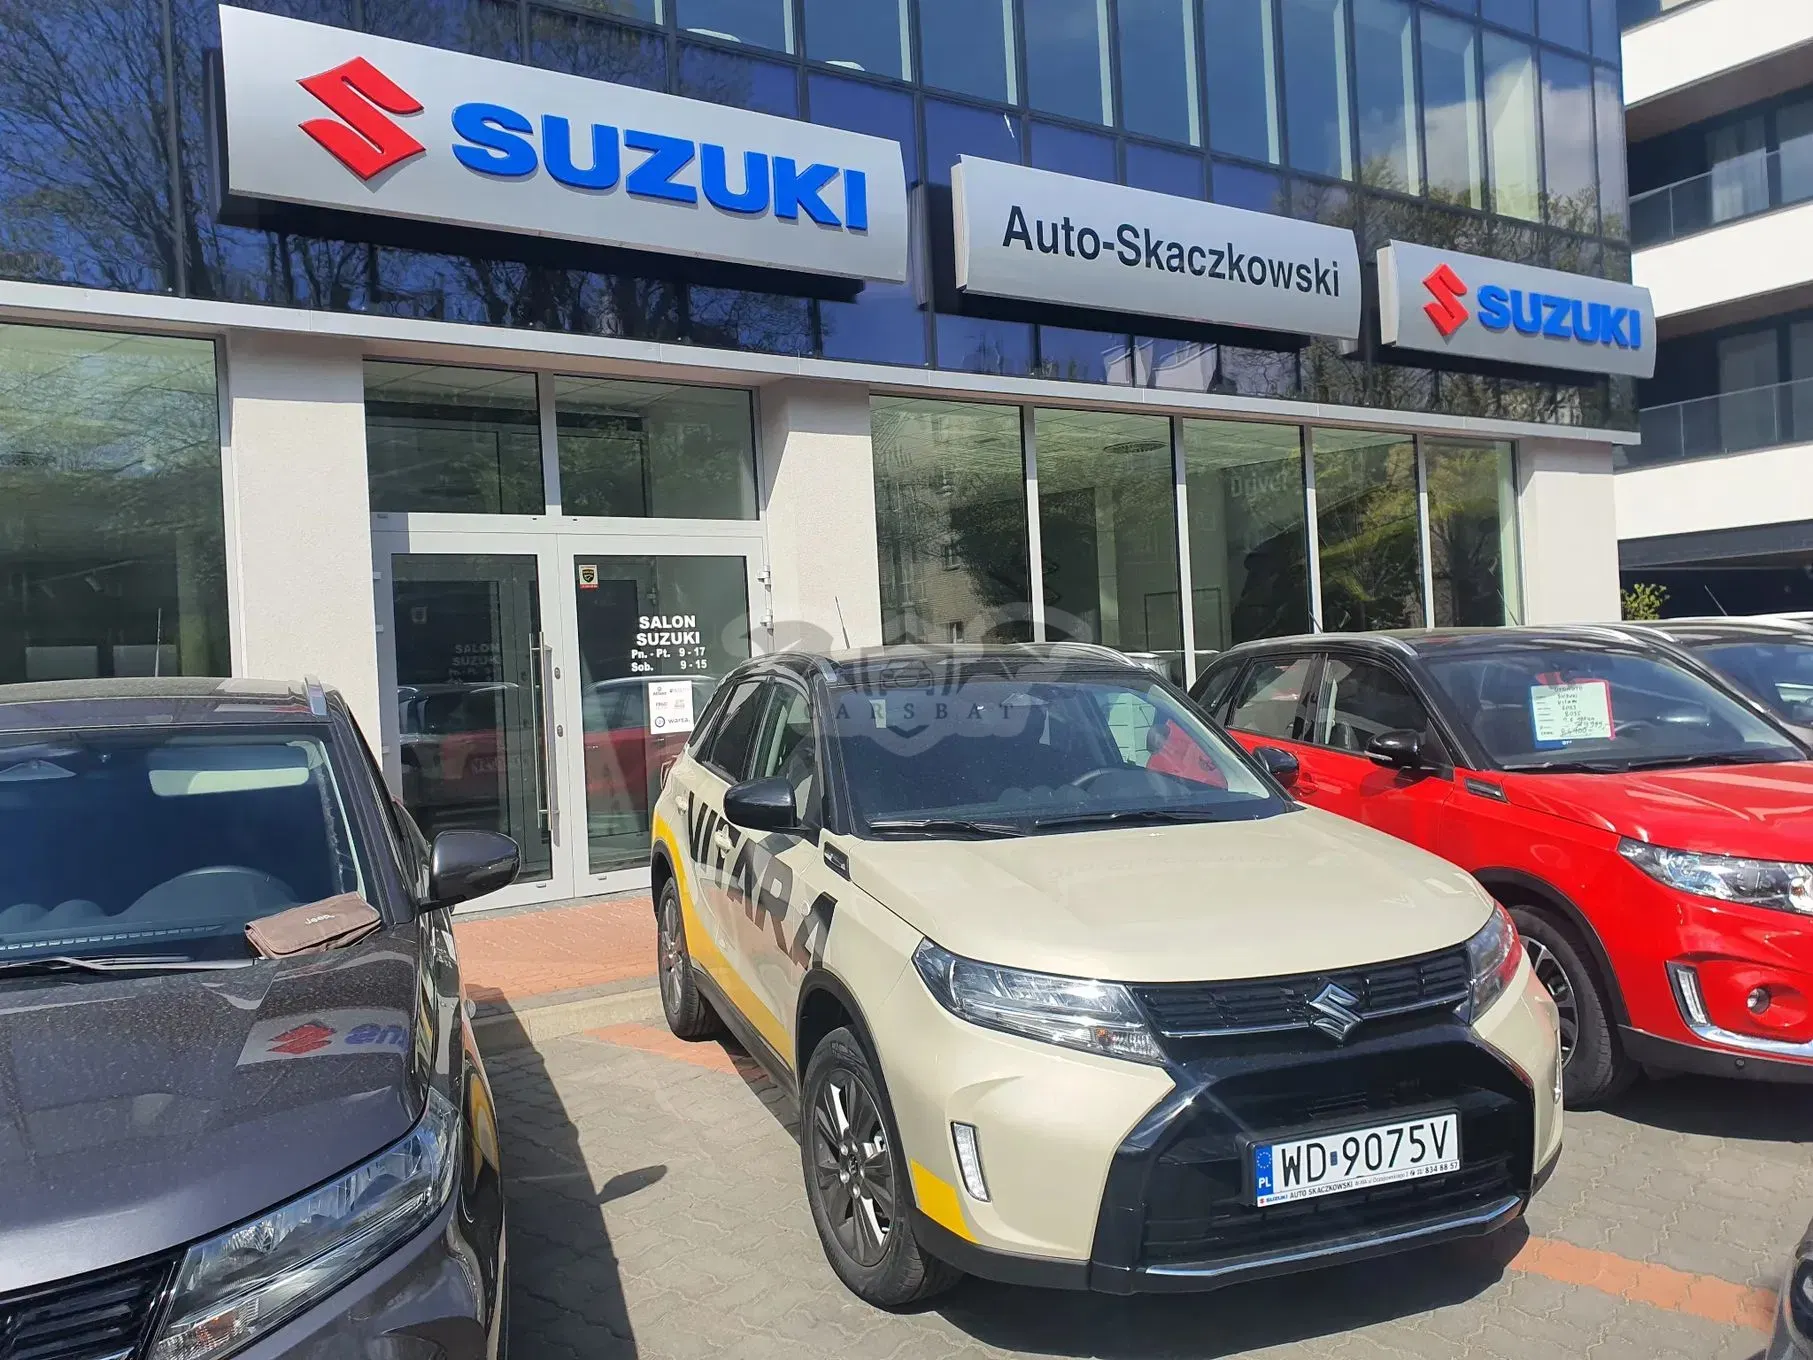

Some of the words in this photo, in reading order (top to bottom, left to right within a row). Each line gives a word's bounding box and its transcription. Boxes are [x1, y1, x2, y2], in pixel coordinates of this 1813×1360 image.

[450, 102, 868, 233] SUZUKI
[1001, 204, 1340, 299] Auto-Skaczkowski
[1477, 284, 1641, 350] SUZUKI
[636, 631, 700, 646] SUZUKI
[639, 615, 696, 629] SALON
[631, 649, 648, 659] Pn.
[656, 648, 671, 658] Pt.
[678, 647, 686, 657] 9
[694, 646, 706, 656] 17
[631, 661, 654, 672] Sob.
[680, 660, 687, 670] 9
[695, 659, 708, 669] 15
[688, 790, 838, 971] VITARA
[1281, 1142, 1327, 1187] WD
[1342, 1120, 1448, 1177] 9075V
[1258, 1177, 1271, 1188] PL
[1289, 1190, 1307, 1199] AUTO
[1308, 1181, 1354, 1195] SKACZKOWSKI
[1425, 1166, 1438, 1174] 834
[1440, 1163, 1448, 1171] 88
[1450, 1161, 1458, 1169] 57
